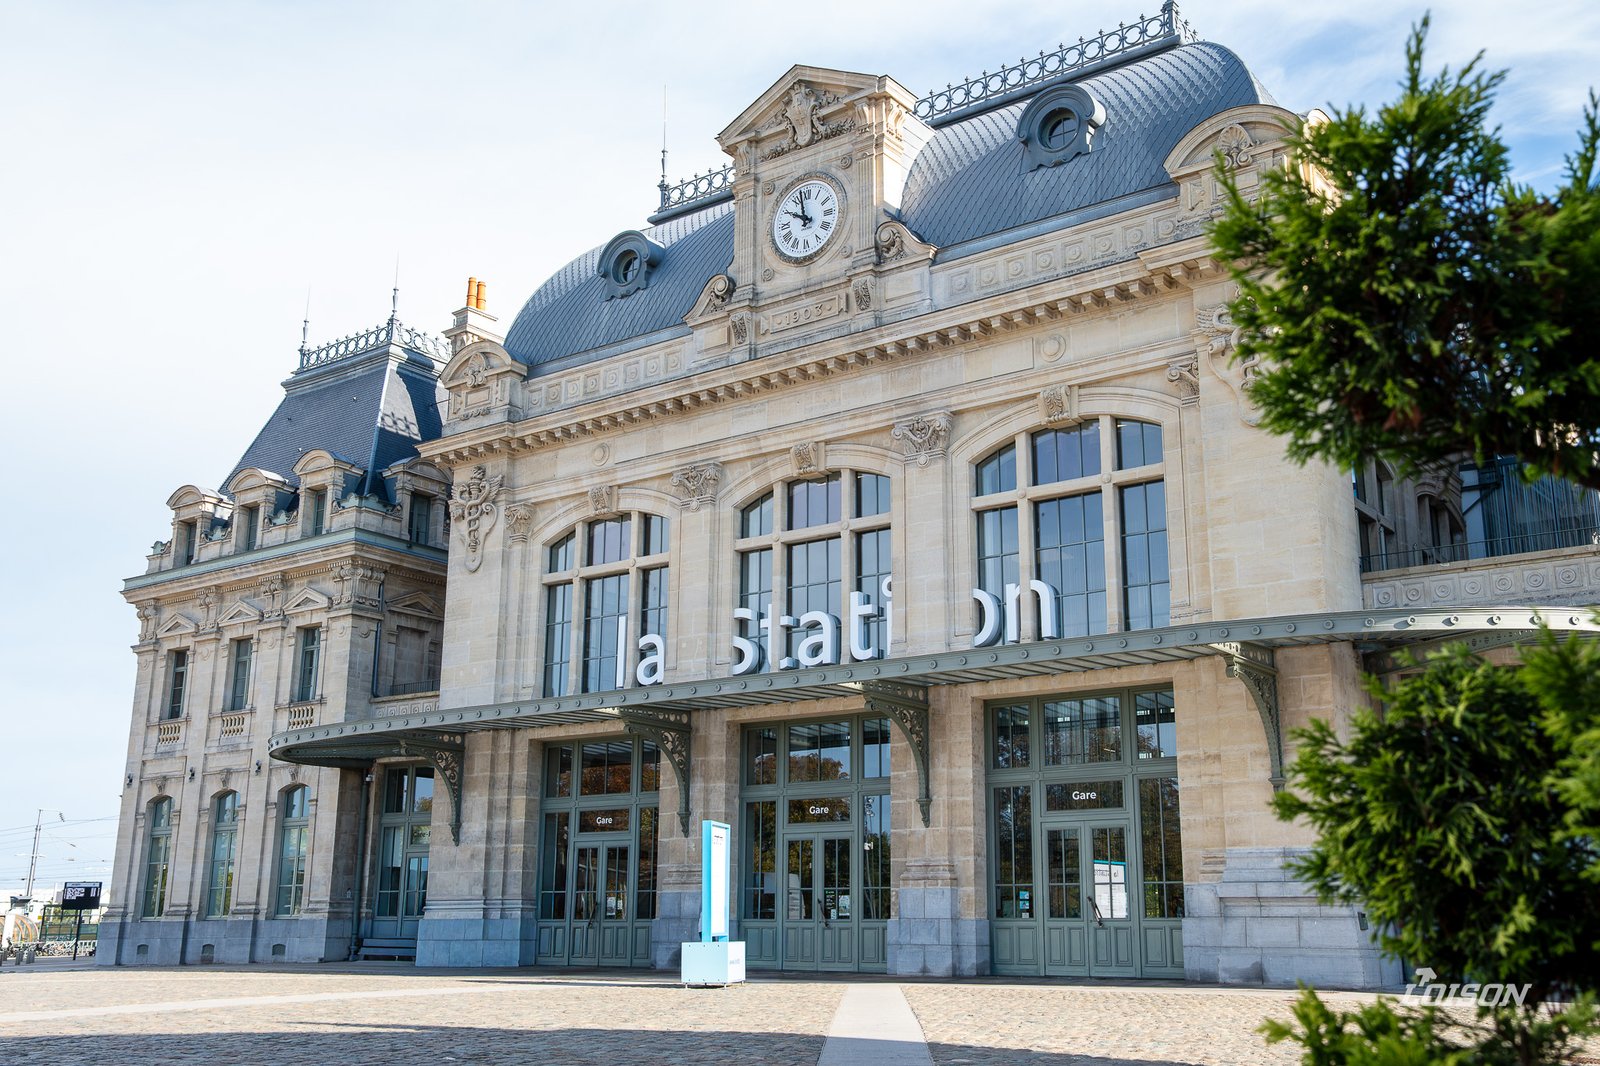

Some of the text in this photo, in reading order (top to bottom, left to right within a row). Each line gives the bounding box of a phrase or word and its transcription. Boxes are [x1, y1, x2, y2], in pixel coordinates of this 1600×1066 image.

[785, 304, 823, 326] 1903
[616, 616, 665, 688] la
[1072, 790, 1097, 801] Gare
[809, 805, 829, 815] Gare
[596, 816, 613, 825] Gare
